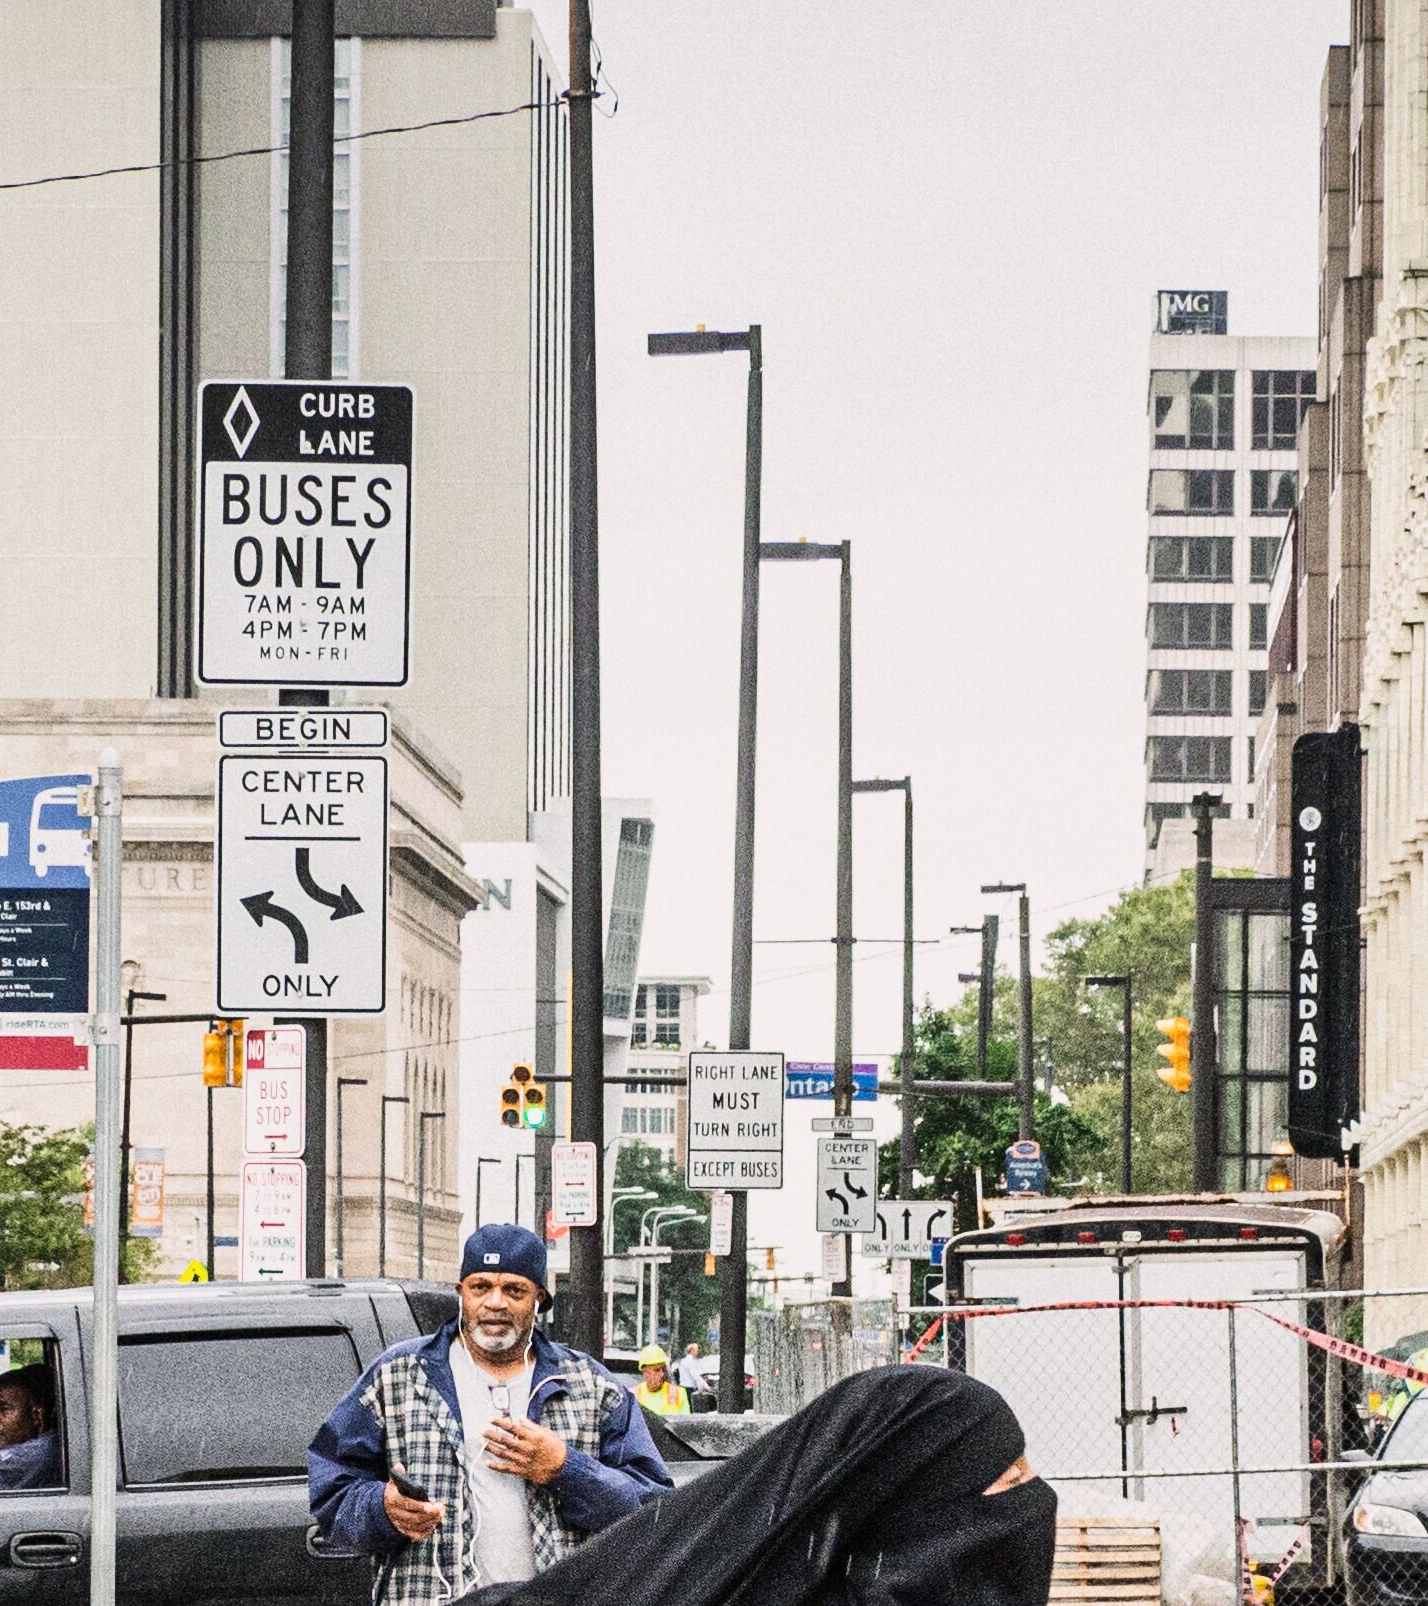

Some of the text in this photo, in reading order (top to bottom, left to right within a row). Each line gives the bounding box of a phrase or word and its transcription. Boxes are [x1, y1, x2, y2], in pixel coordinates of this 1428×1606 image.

[299, 393, 376, 419] CURB
[298, 430, 375, 456] LANE
[222, 473, 393, 529] BUSES
[233, 536, 377, 589] ONLY
[244, 595, 292, 614] 7AM
[316, 595, 366, 615] 9AM
[242, 621, 293, 640] 4PM
[317, 621, 367, 641] 7PM
[256, 718, 351, 741] BEGIN
[241, 770, 365, 794] CENTER
[260, 803, 345, 826] LANE
[1303, 841, 1317, 890] THE
[15, 900, 42, 911] 153rd
[43, 900, 51, 911] &
[16, 957, 40, 967] Clair
[40, 957, 49, 967] &
[262, 974, 340, 998] ONLY
[1298, 901, 1319, 1091] STANDARD
[247, 1039, 264, 1061] NO
[695, 1065, 778, 1080] RIGHT LANE
[259, 1080, 288, 1100] BUS
[712, 1092, 760, 1111] MUST
[256, 1106, 292, 1125] STOP
[830, 1119, 855, 1130] END
[694, 1122, 778, 1137] TURN RIGHT
[825, 1143, 869, 1153] CENTER
[693, 1161, 778, 1178] EXCEPT BUSES
[831, 1155, 862, 1166] LANE
[246, 1172, 300, 1187] NO STOPPING
[831, 1217, 860, 1228] ONLY
[864, 1242, 889, 1253] ONLY
[893, 1242, 919, 1253] ONLY
